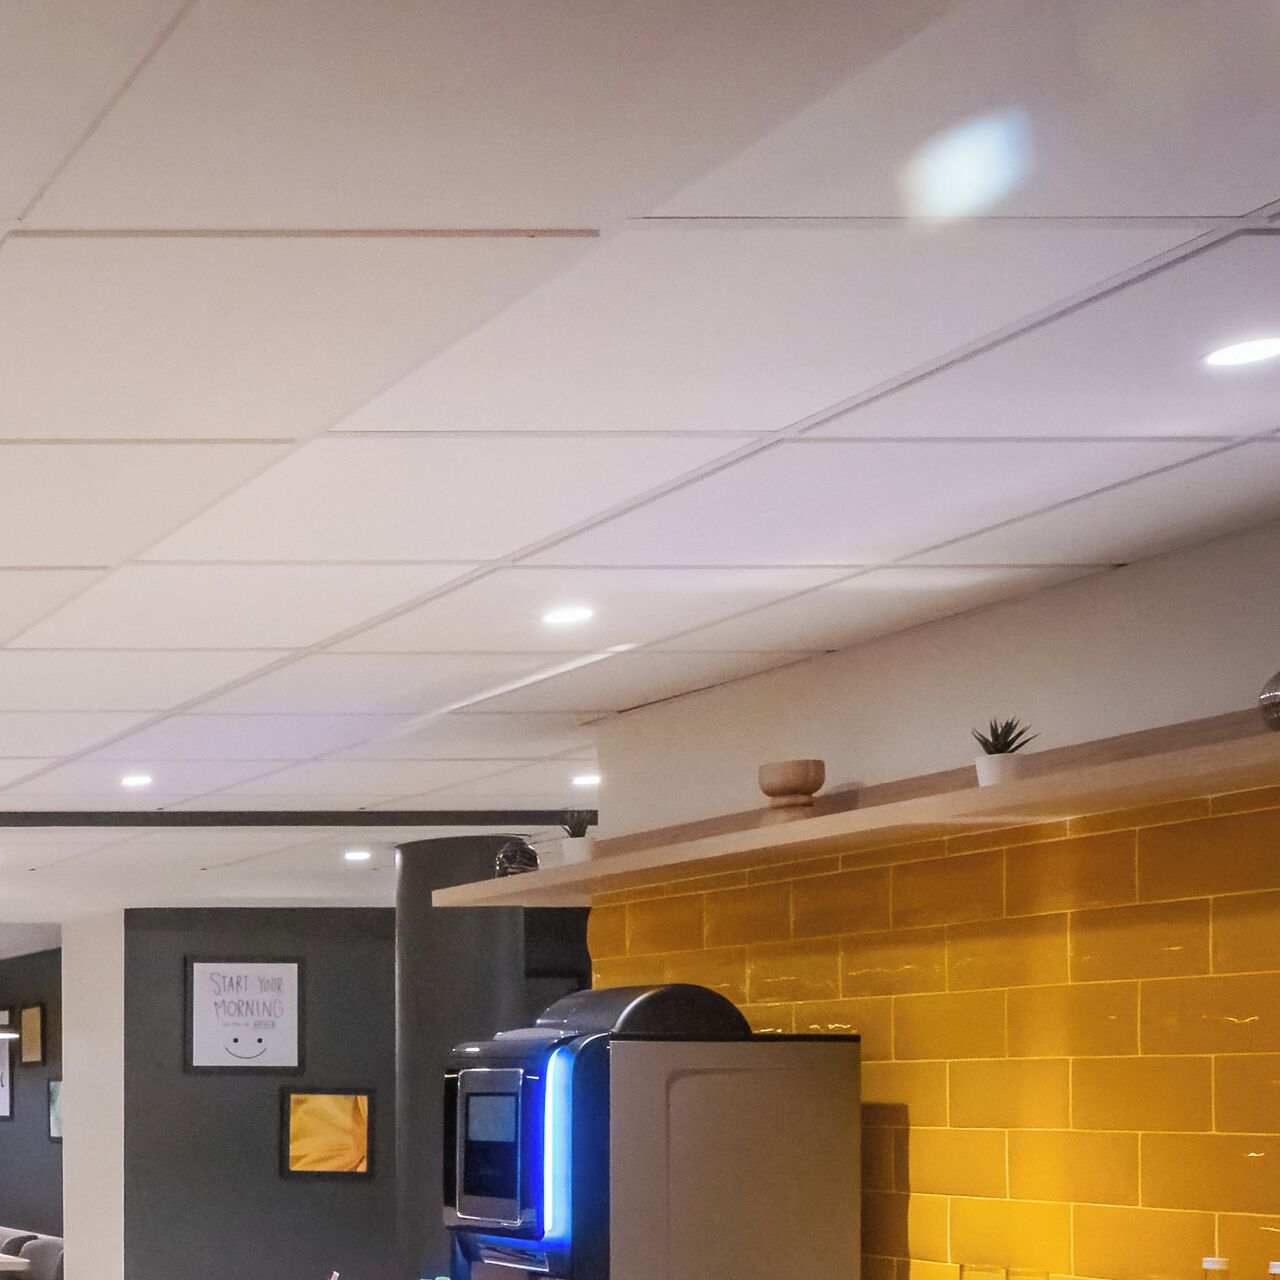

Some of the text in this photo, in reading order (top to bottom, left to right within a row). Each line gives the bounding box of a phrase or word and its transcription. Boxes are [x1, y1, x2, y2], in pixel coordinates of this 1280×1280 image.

[209, 972, 283, 996] START YOUR
[214, 999, 284, 1019] MORNING
